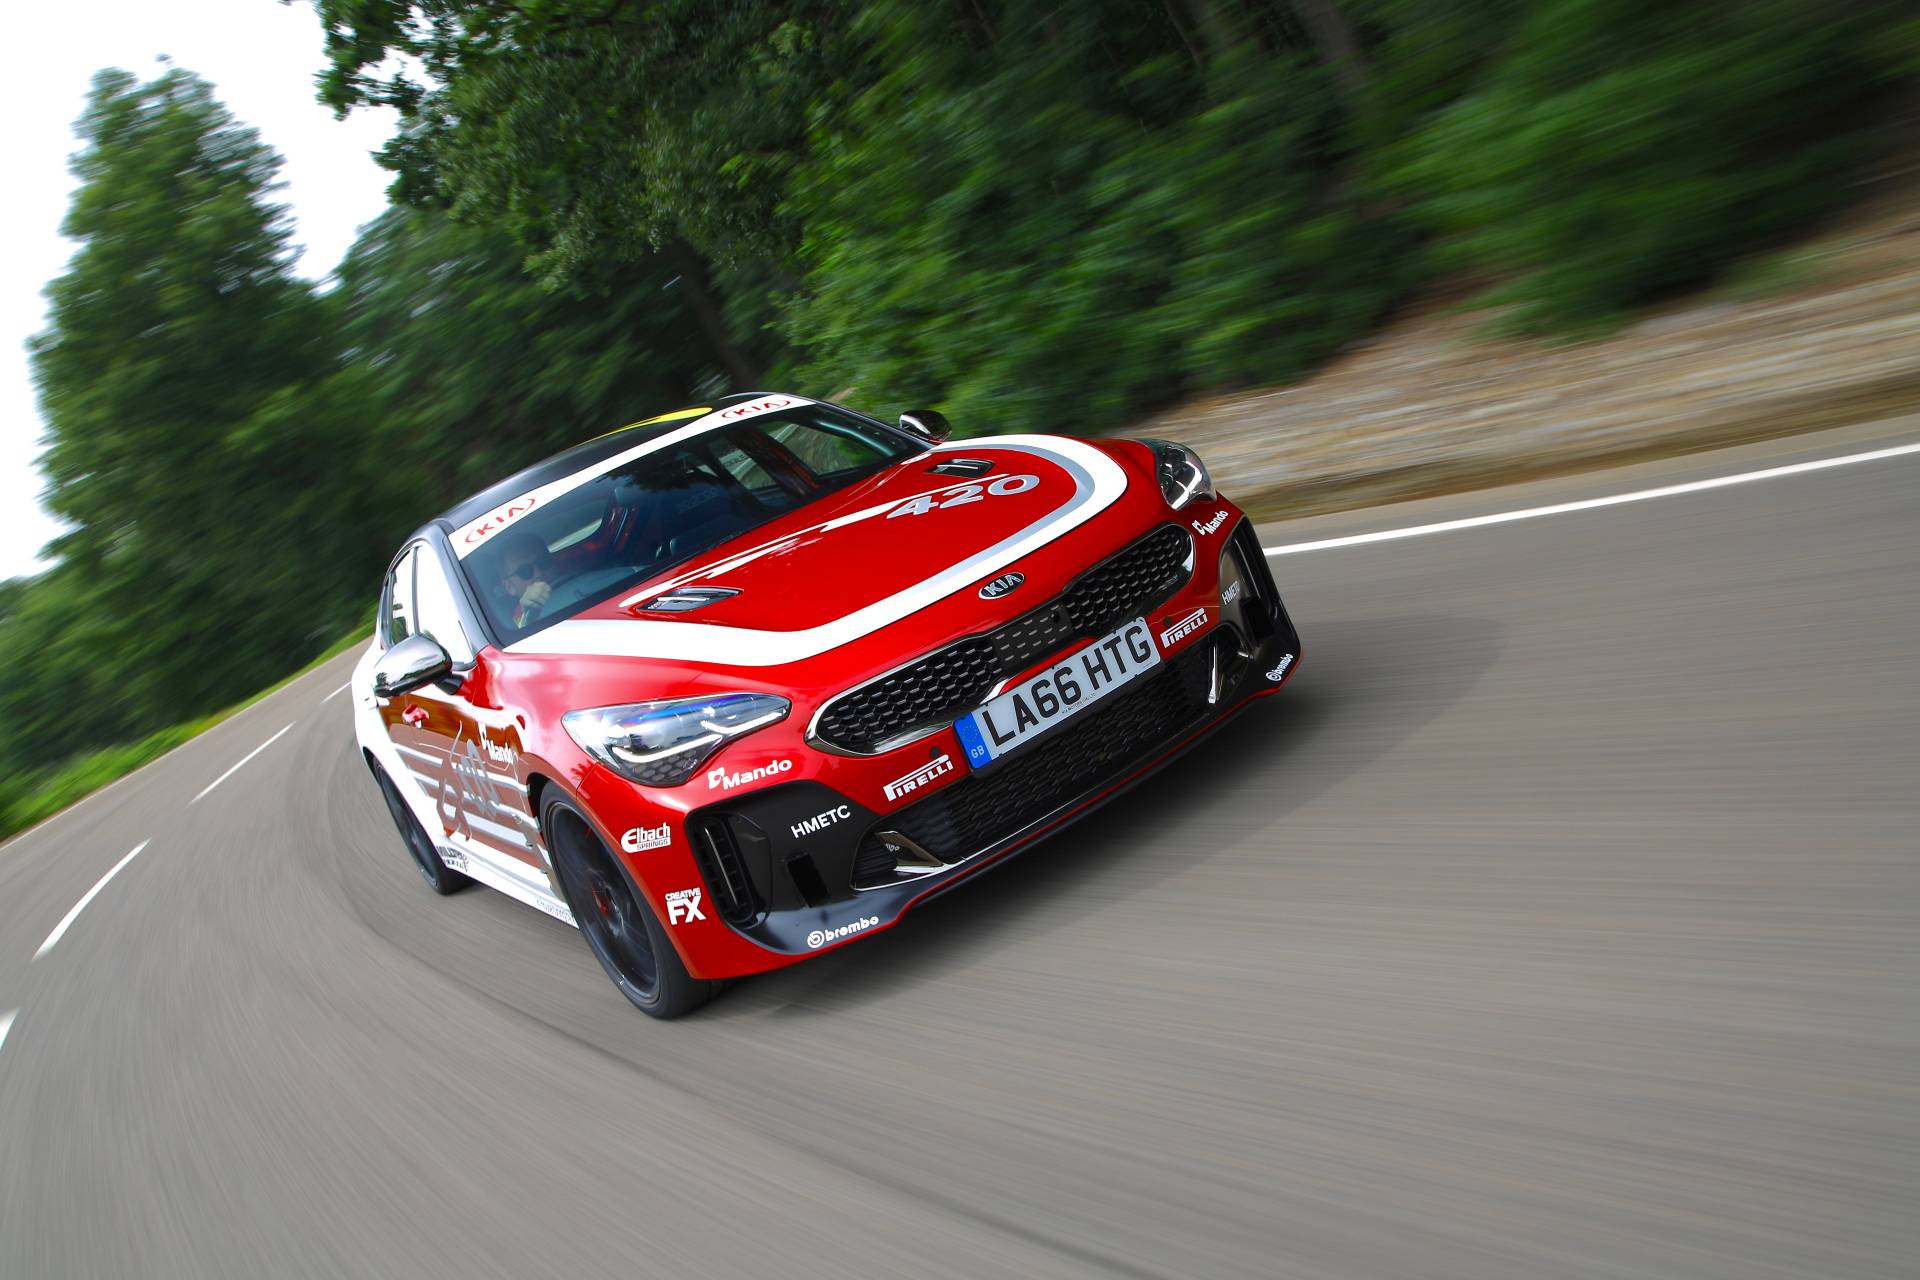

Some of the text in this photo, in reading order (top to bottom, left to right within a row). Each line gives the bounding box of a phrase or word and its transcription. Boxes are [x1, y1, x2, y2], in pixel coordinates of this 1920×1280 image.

[731, 402, 782, 416] KIA
[887, 475, 1040, 519] 420
[475, 505, 526, 537] KIA
[1202, 510, 1229, 535] Mando
[983, 574, 1021, 596] KIA
[1160, 607, 1208, 649] PIRELLI
[982, 625, 1152, 747] LA66 HTG
[970, 745, 985, 759] GB
[722, 759, 793, 790] Mando
[882, 754, 954, 802] PIRELLI
[790, 805, 851, 838] HMETC
[637, 838, 668, 850] SPRINGS
[665, 887, 701, 900] CREATIVE
[666, 895, 706, 925] FX
[825, 916, 879, 941] brembo
